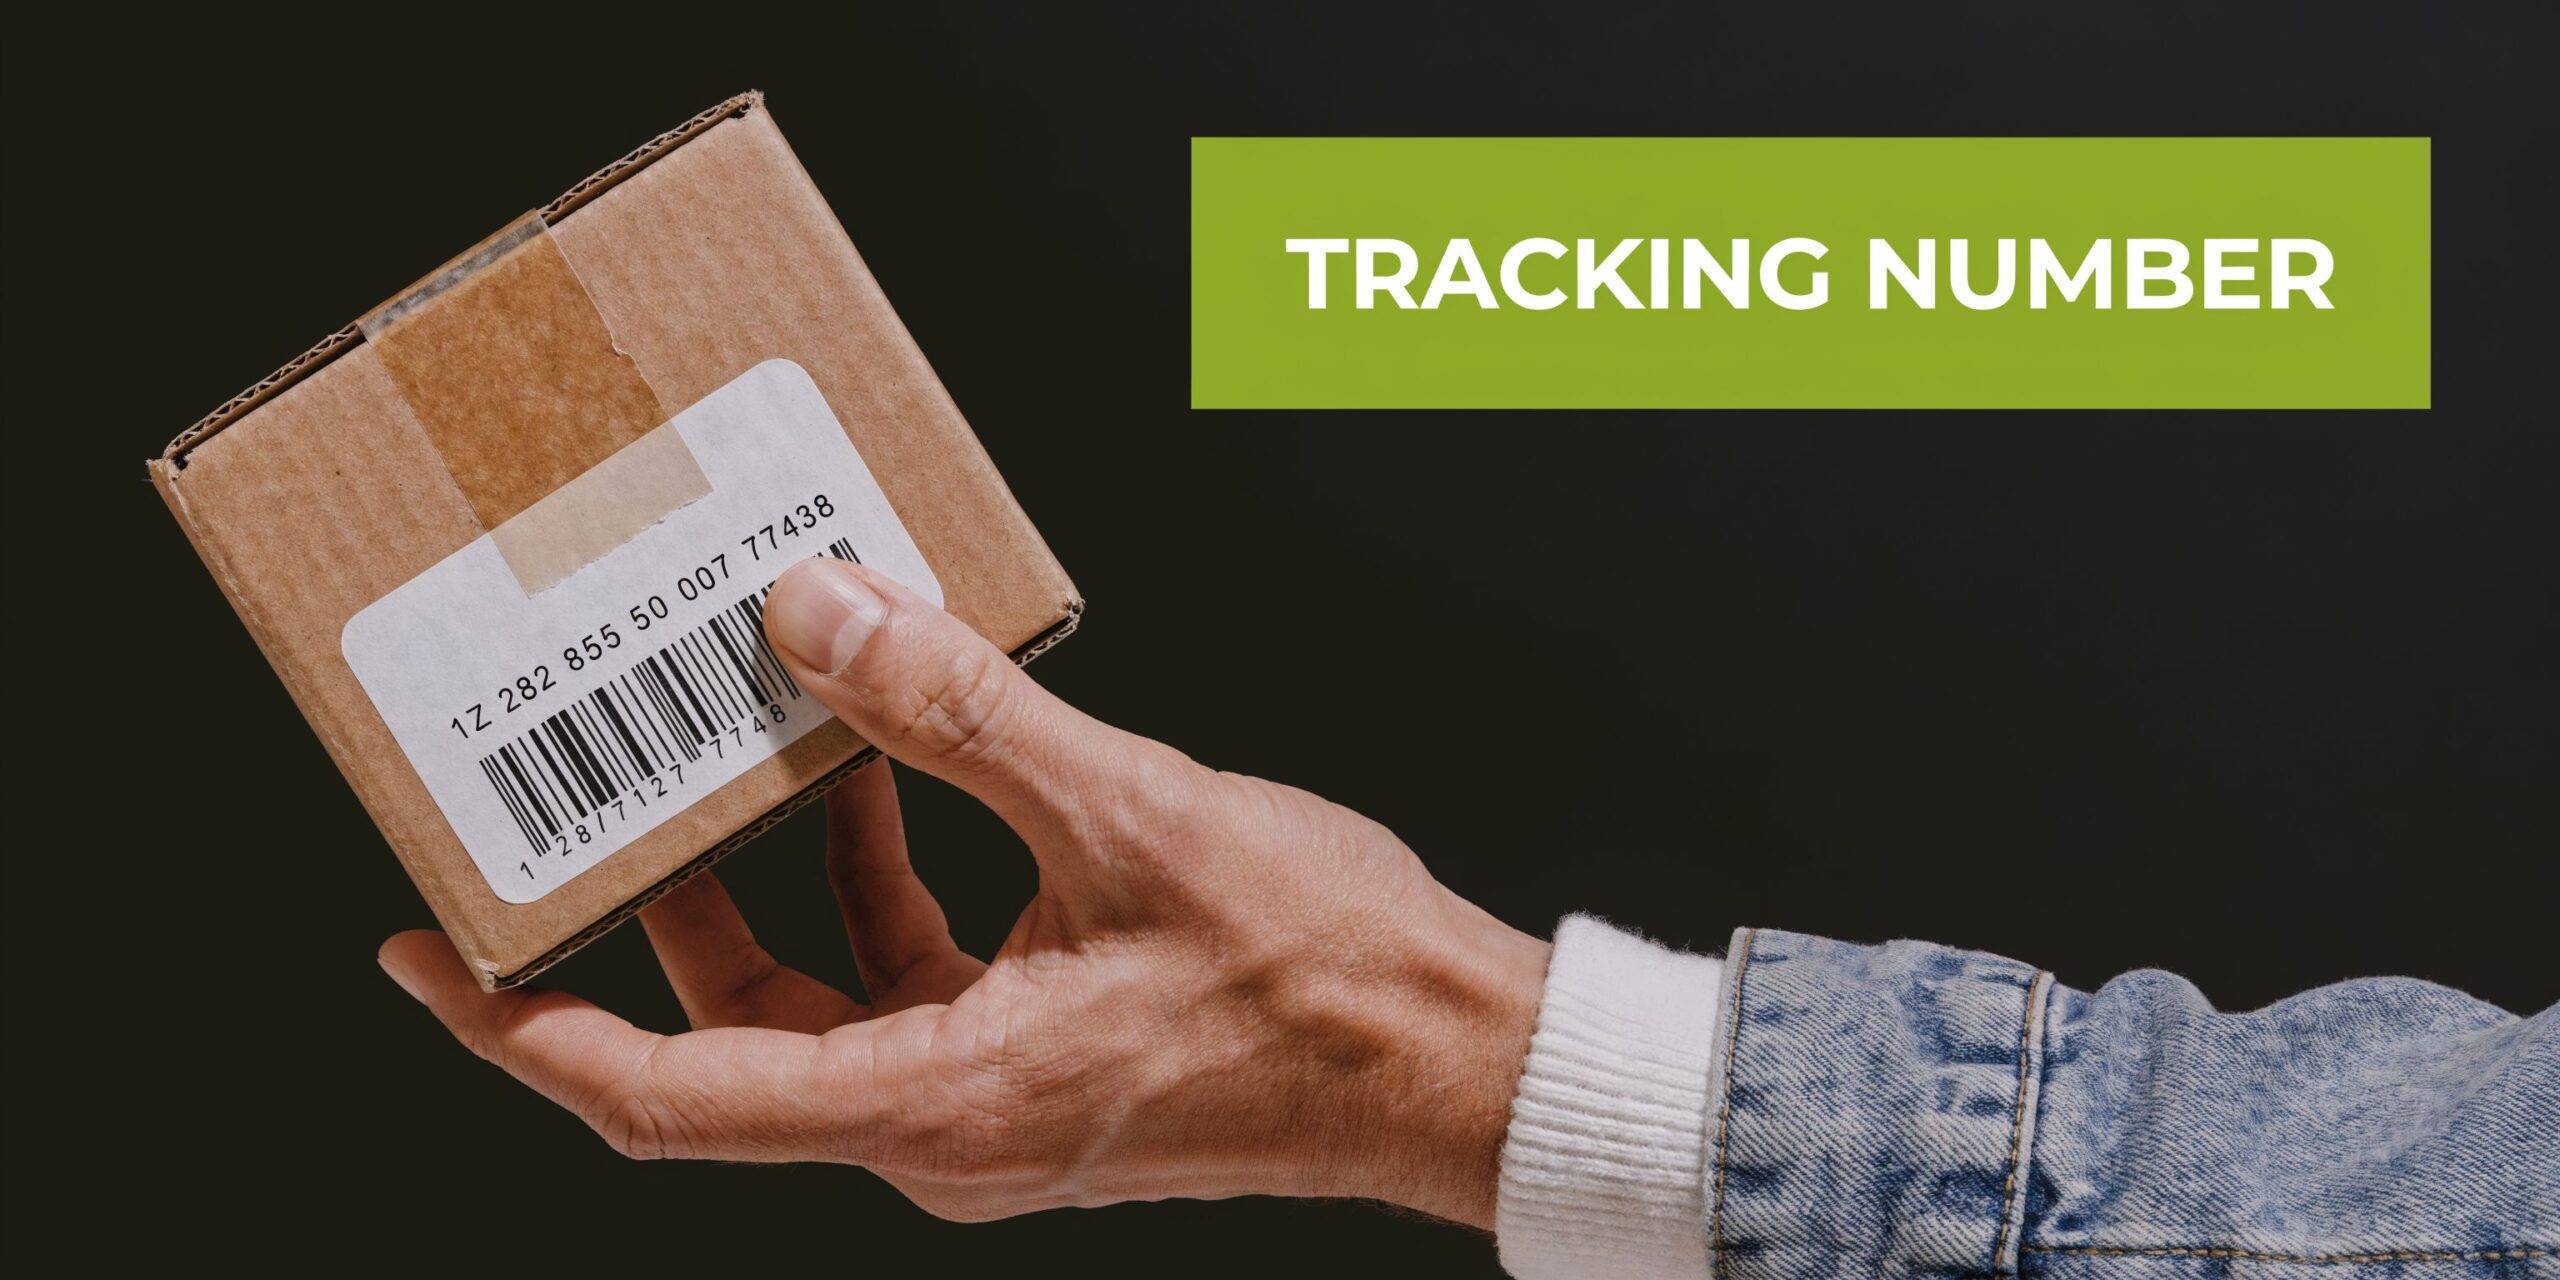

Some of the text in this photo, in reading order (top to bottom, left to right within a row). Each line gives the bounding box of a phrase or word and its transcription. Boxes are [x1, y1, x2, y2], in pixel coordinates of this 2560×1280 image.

[451, 494, 835, 739] 1Z 282 855 50 007 77438
